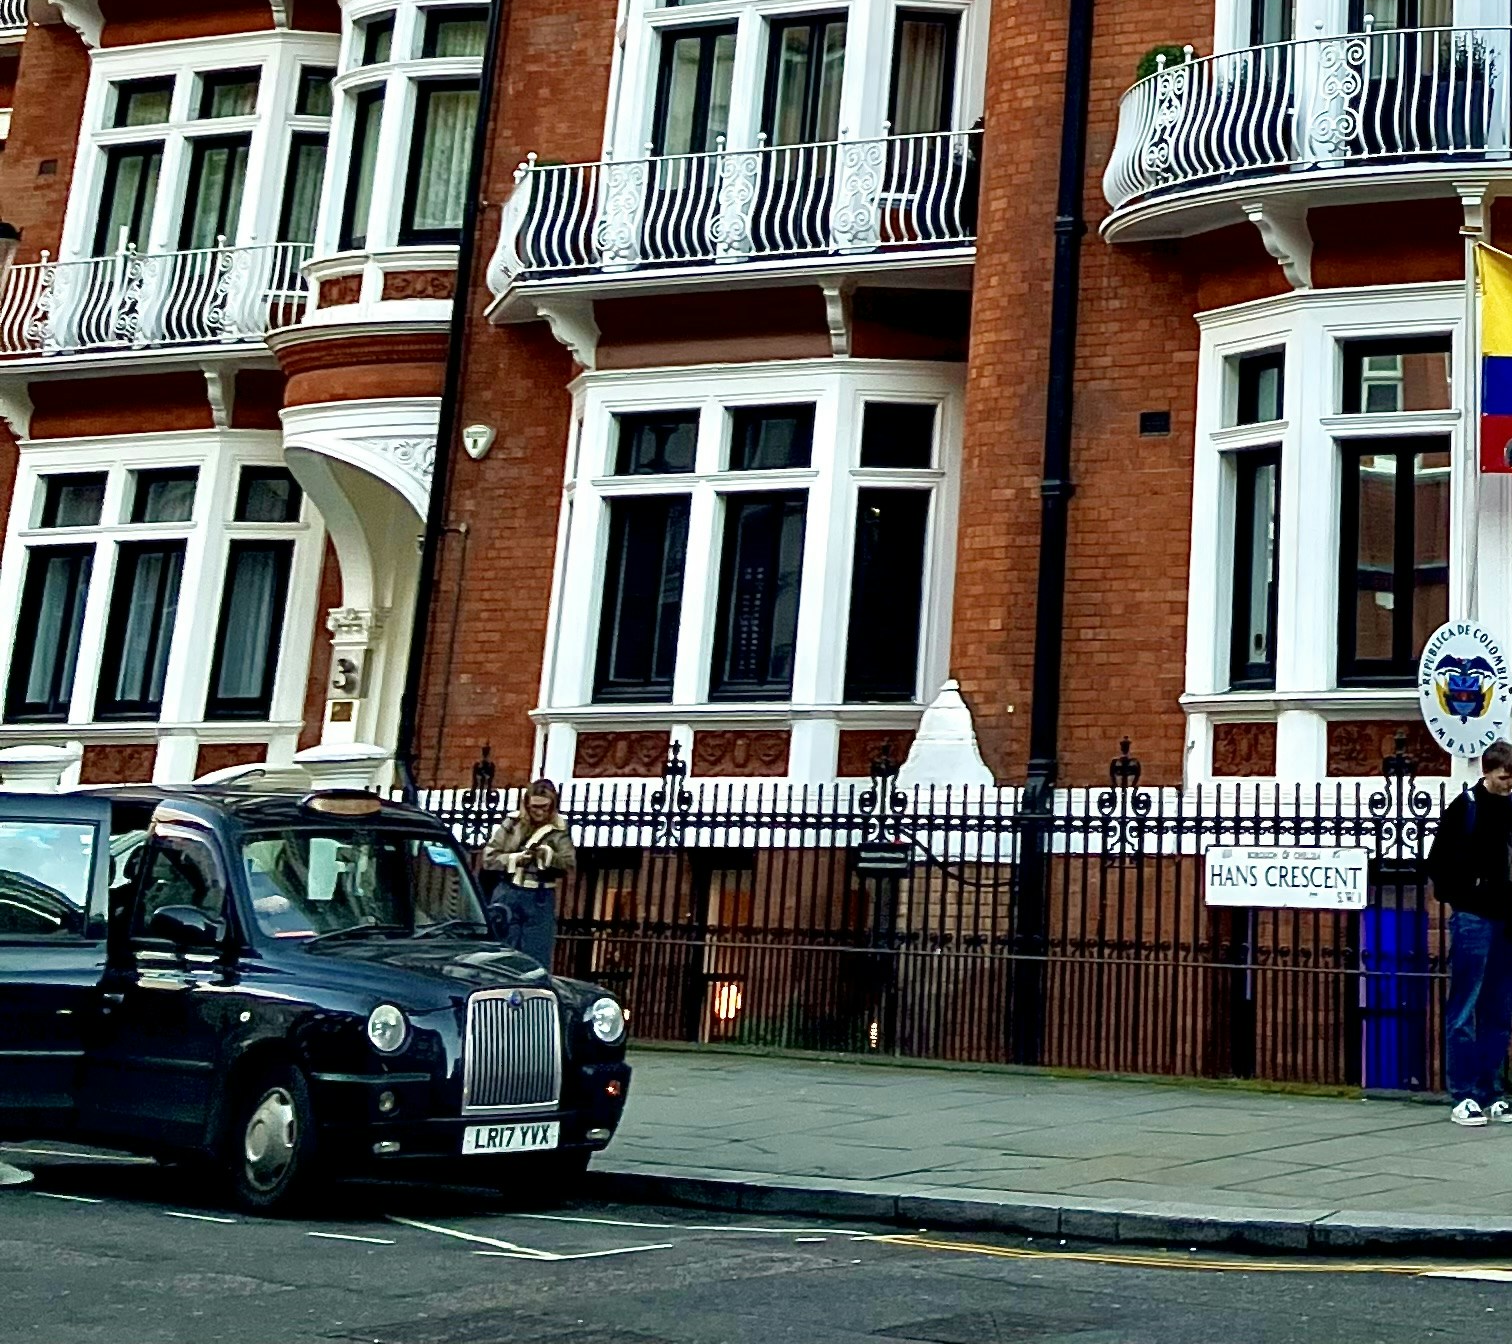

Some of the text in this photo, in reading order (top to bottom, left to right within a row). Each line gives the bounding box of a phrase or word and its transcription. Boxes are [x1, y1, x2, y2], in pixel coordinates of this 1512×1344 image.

[1457, 624, 1471, 635] DE
[1473, 628, 1508, 690] COLOMBIA
[333, 658, 358, 694] 3
[1429, 717, 1503, 754] EMBAJADA
[1210, 864, 1363, 890] HANS CRESCENT
[475, 1123, 550, 1149] LR17 YVX
